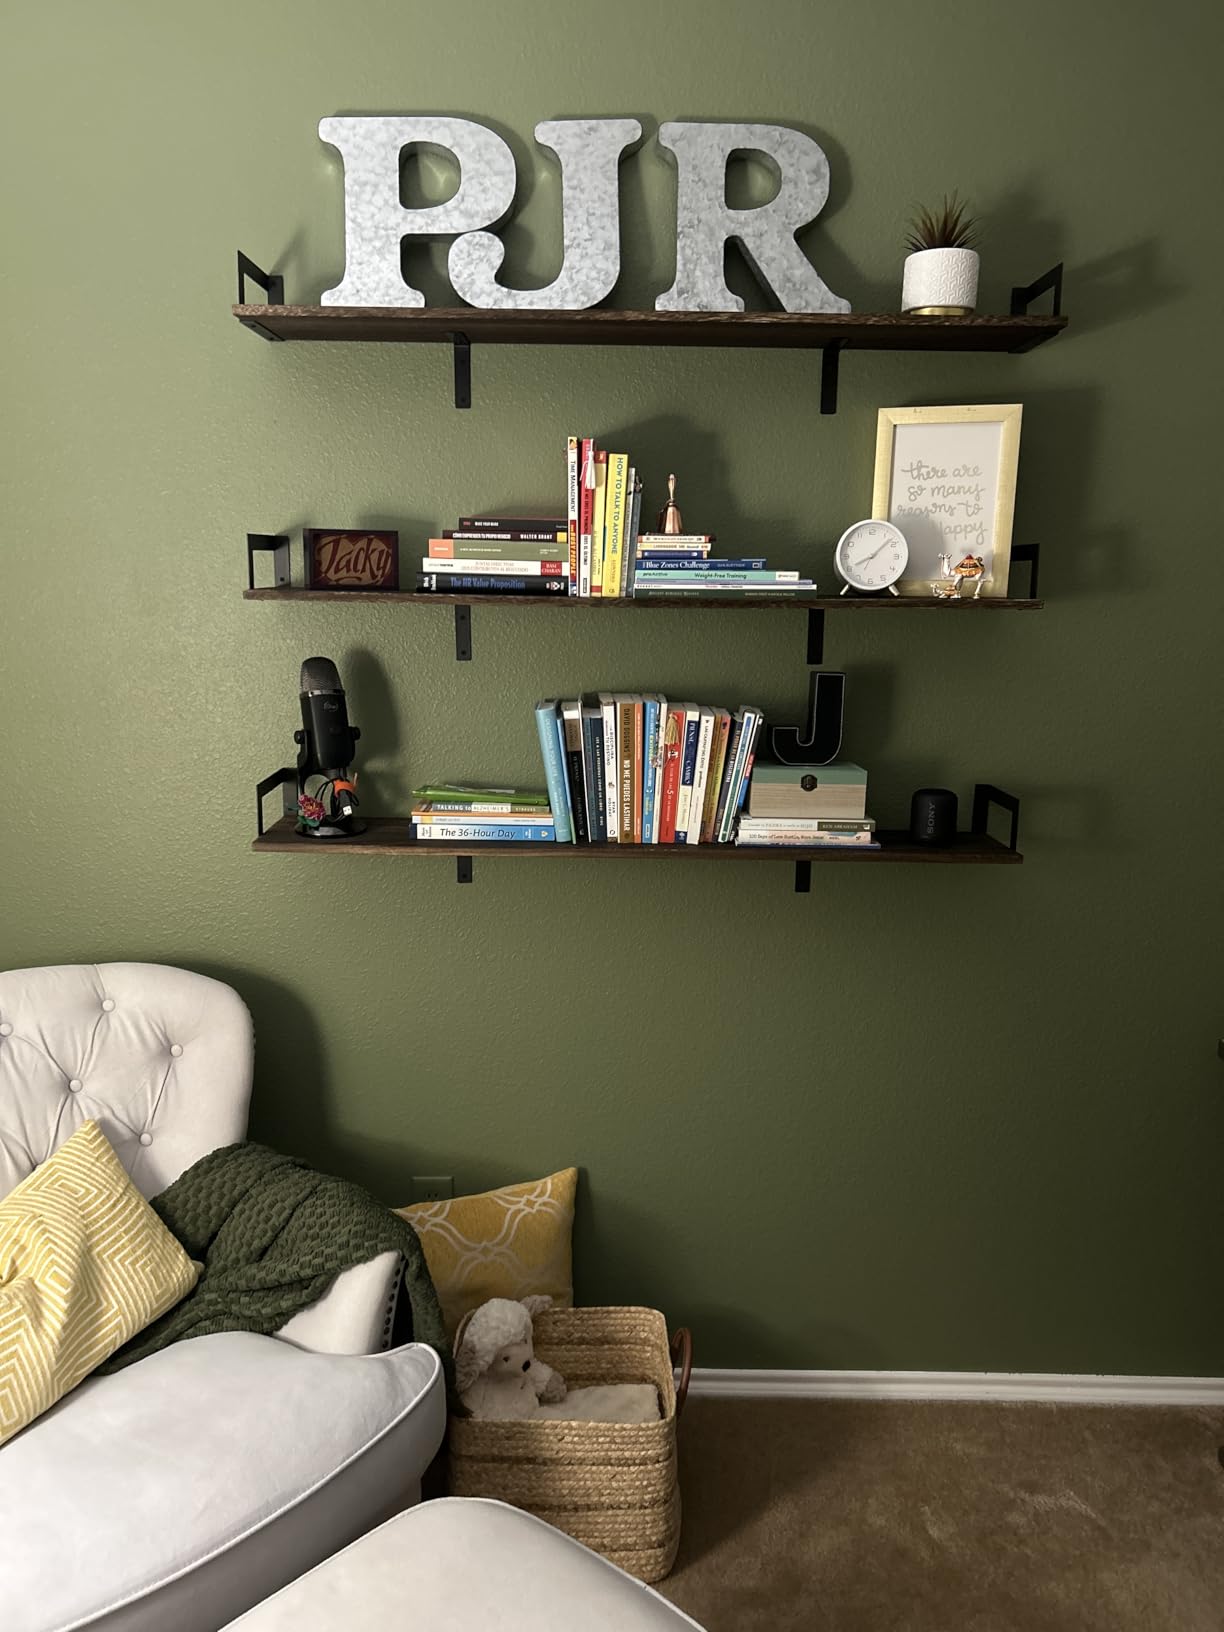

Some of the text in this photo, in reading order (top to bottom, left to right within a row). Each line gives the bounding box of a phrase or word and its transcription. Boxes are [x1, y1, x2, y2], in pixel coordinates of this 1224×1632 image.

[901, 460, 983, 481] there are
[907, 482, 986, 502] so many
[611, 457, 624, 555] HOW TO TALK TO ANYONE
[897, 500, 984, 518] reasons to
[317, 536, 392, 584] Jacky
[680, 561, 710, 570] Challenge
[450, 577, 461, 587] The
[473, 577, 489, 588] Value
[490, 578, 525, 589] Proposition
[880, 574, 886, 582] 5
[623, 708, 631, 725] DAVID
[770, 671, 845, 766] J
[545, 718, 554, 749] DESIGNING
[623, 759, 631, 831] NO ME PUEDES LASTIMAR
[927, 802, 935, 834] SONY
[440, 828, 456, 837] The
[458, 829, 496, 838] 36-Hour
[497, 829, 516, 840] Day
